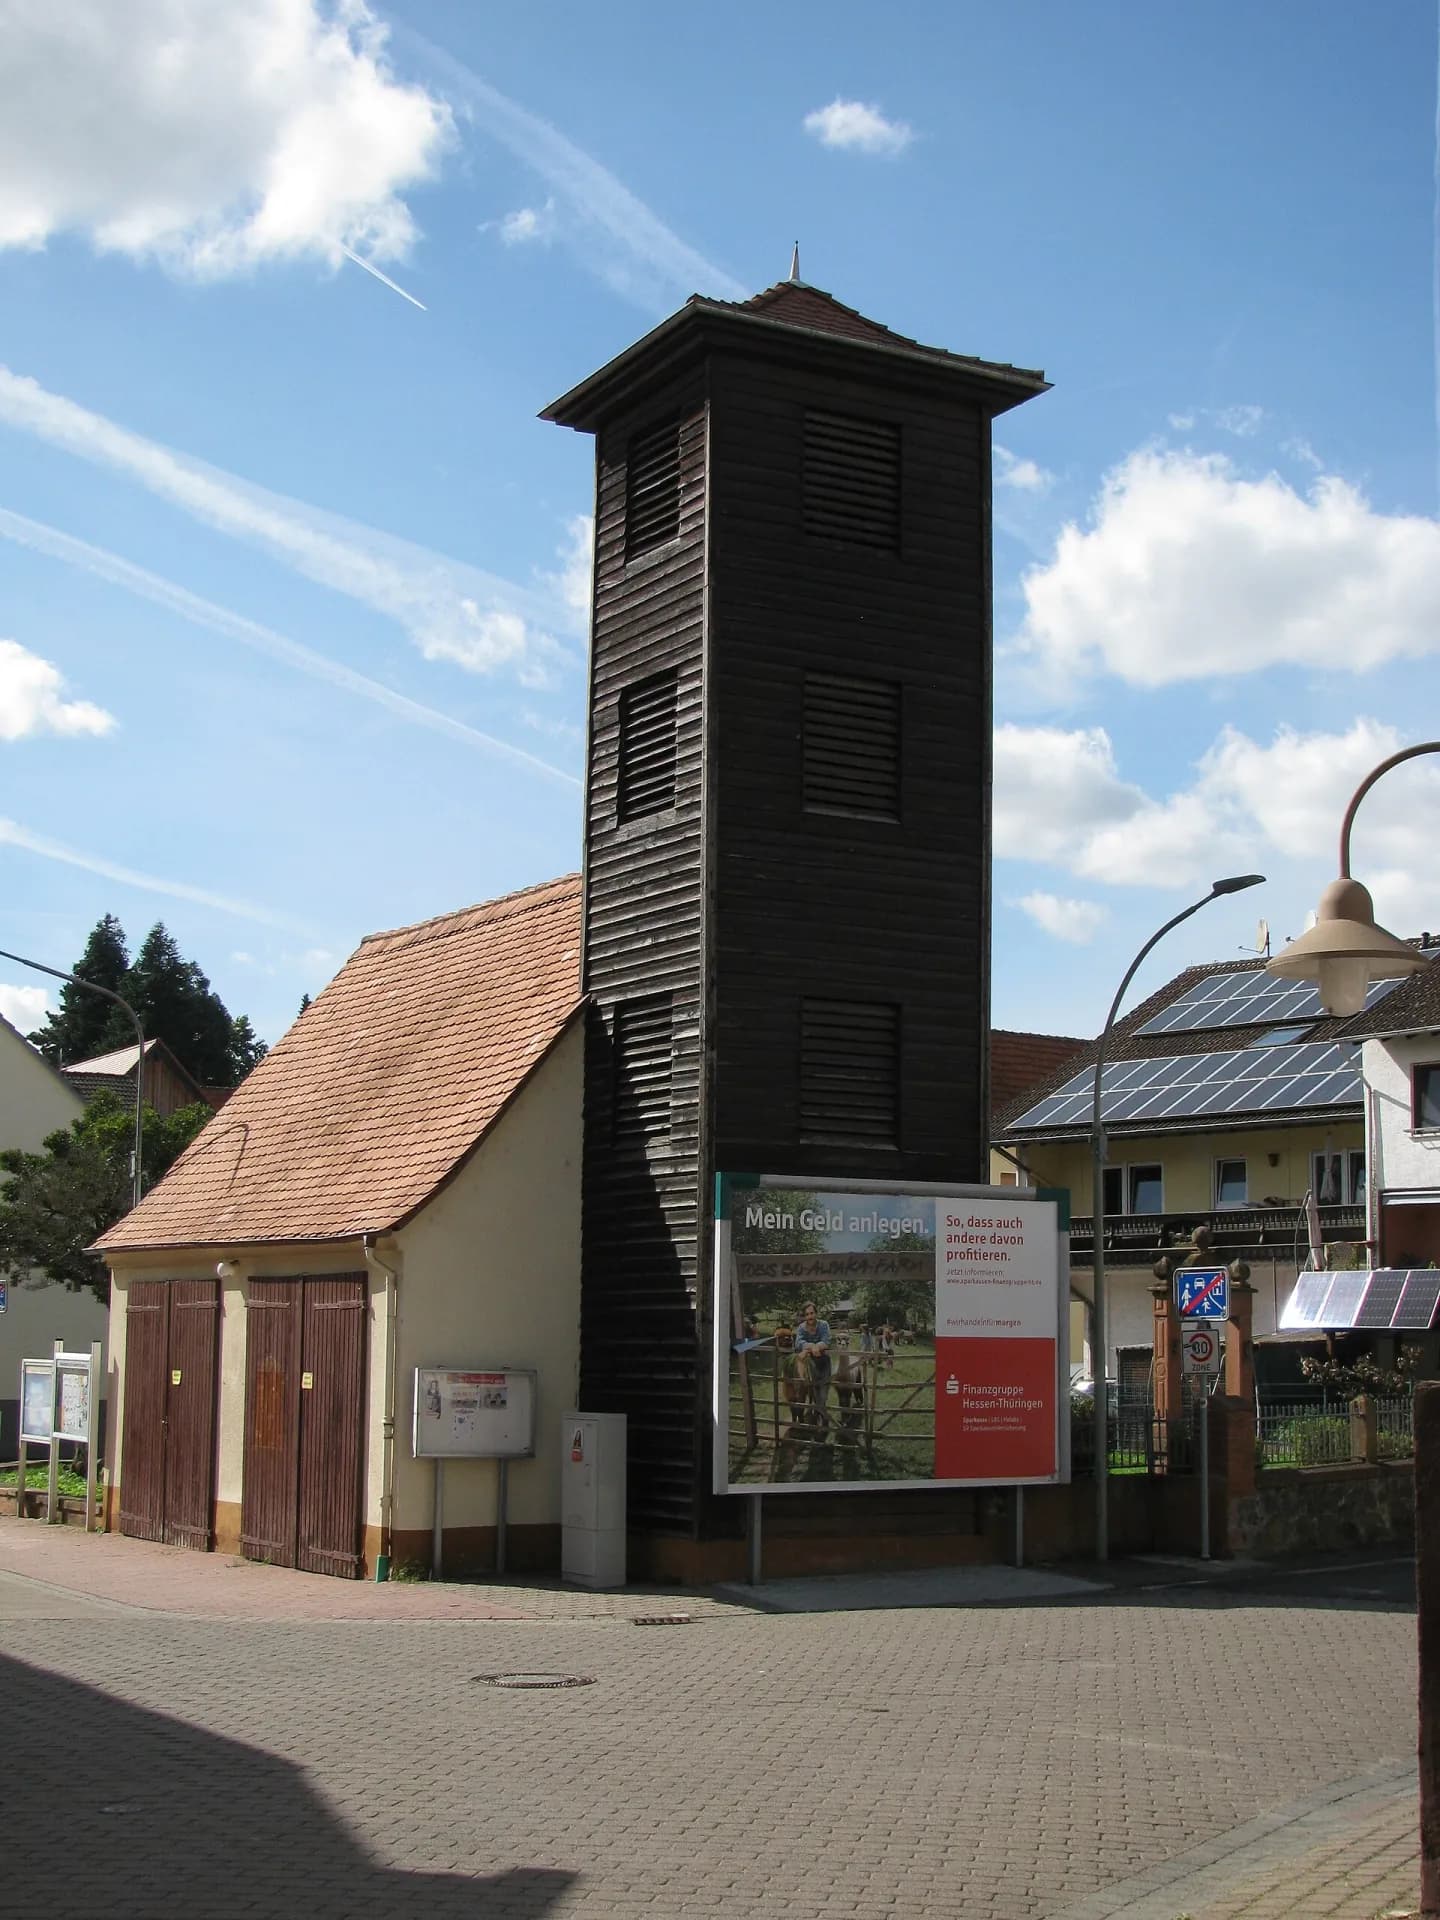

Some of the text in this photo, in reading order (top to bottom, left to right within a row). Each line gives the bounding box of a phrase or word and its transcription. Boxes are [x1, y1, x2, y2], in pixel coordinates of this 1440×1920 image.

[745, 1207, 929, 1239] Mein Geld anlegen.
[946, 1214, 1023, 1229] So, dass auch
[946, 1232, 1024, 1245] andere davon
[946, 1247, 1011, 1262] profitieren.
[946, 1268, 963, 1276] Jetzt
[1192, 1363, 1211, 1371] ZONE
[962, 1383, 1024, 1396] Finanzgruppe
[962, 1397, 1043, 1411] Hessen-Thüringen
